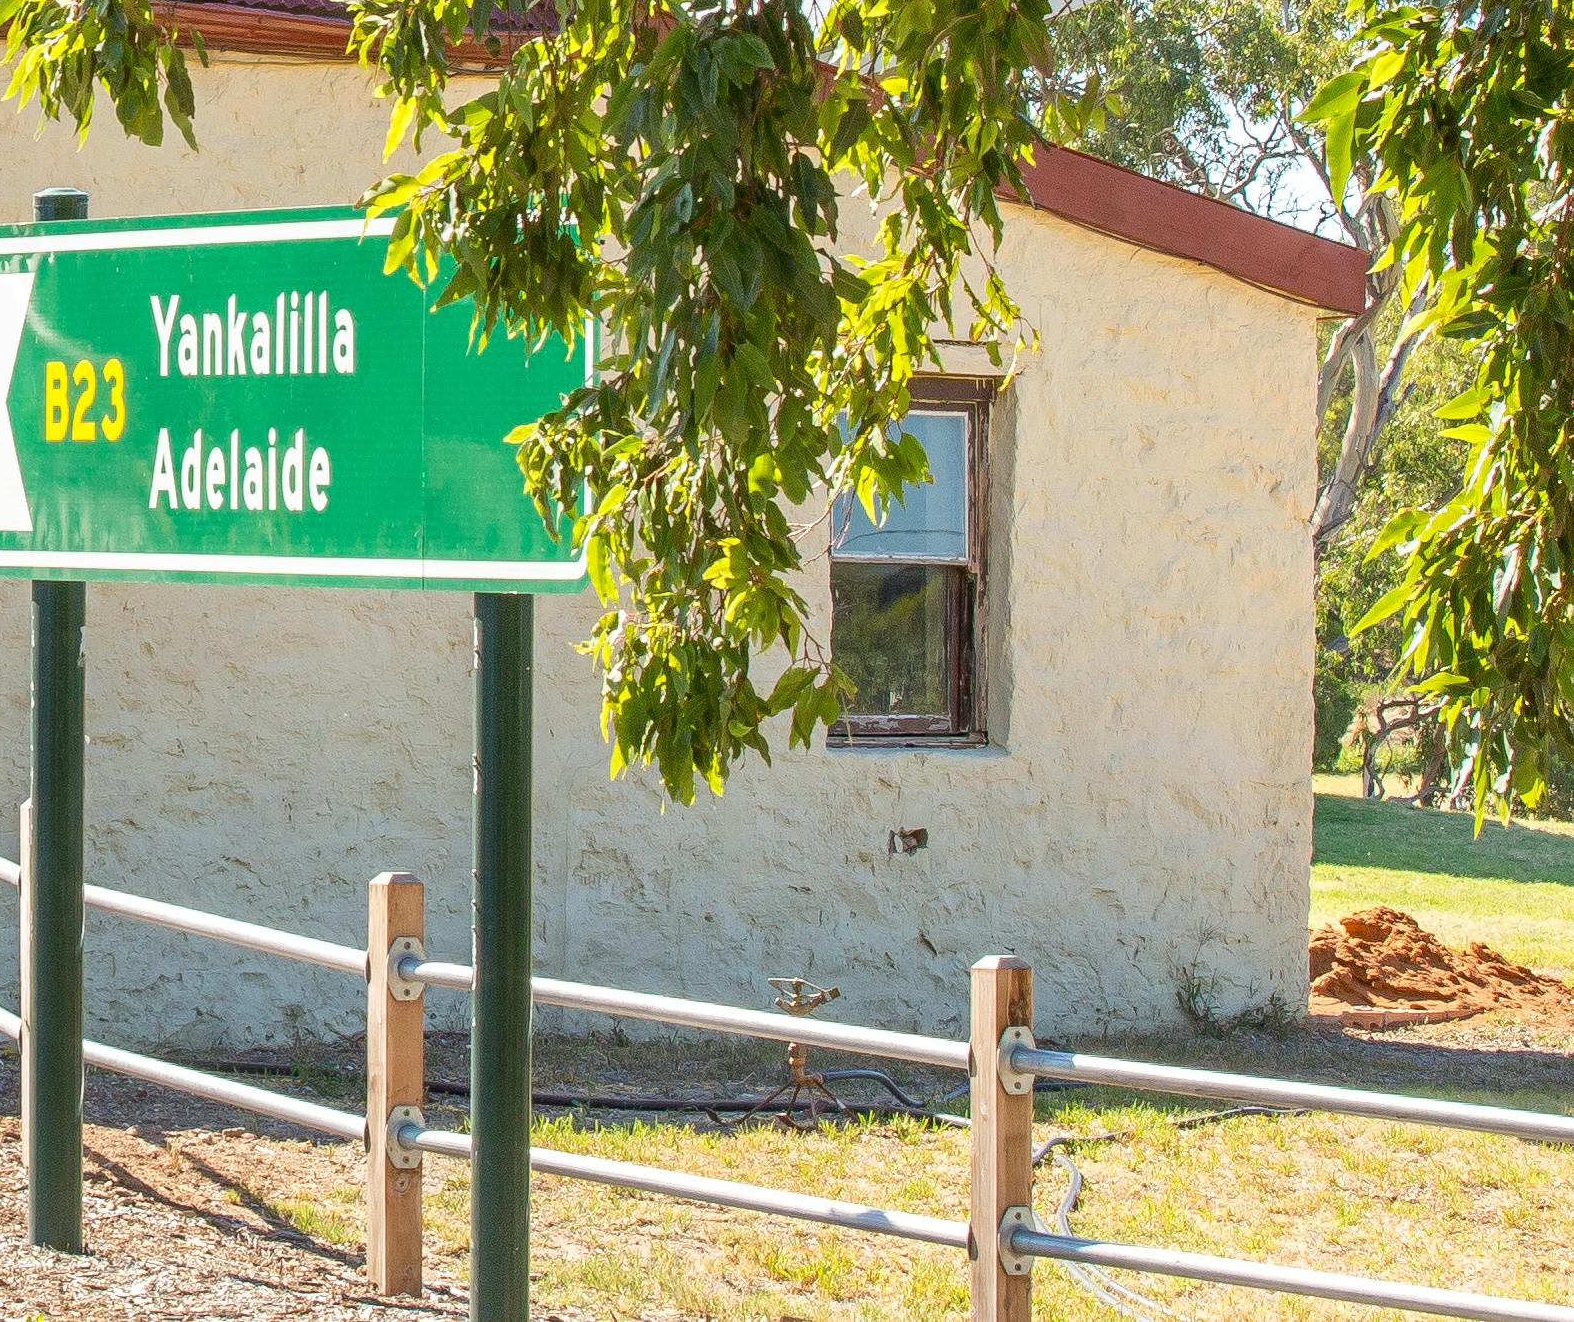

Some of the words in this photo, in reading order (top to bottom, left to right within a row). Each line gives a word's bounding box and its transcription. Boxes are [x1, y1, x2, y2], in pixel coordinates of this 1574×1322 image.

[150, 290, 354, 377] Yankalilla
[45, 359, 125, 441] B23
[148, 427, 331, 511] Adelaide
